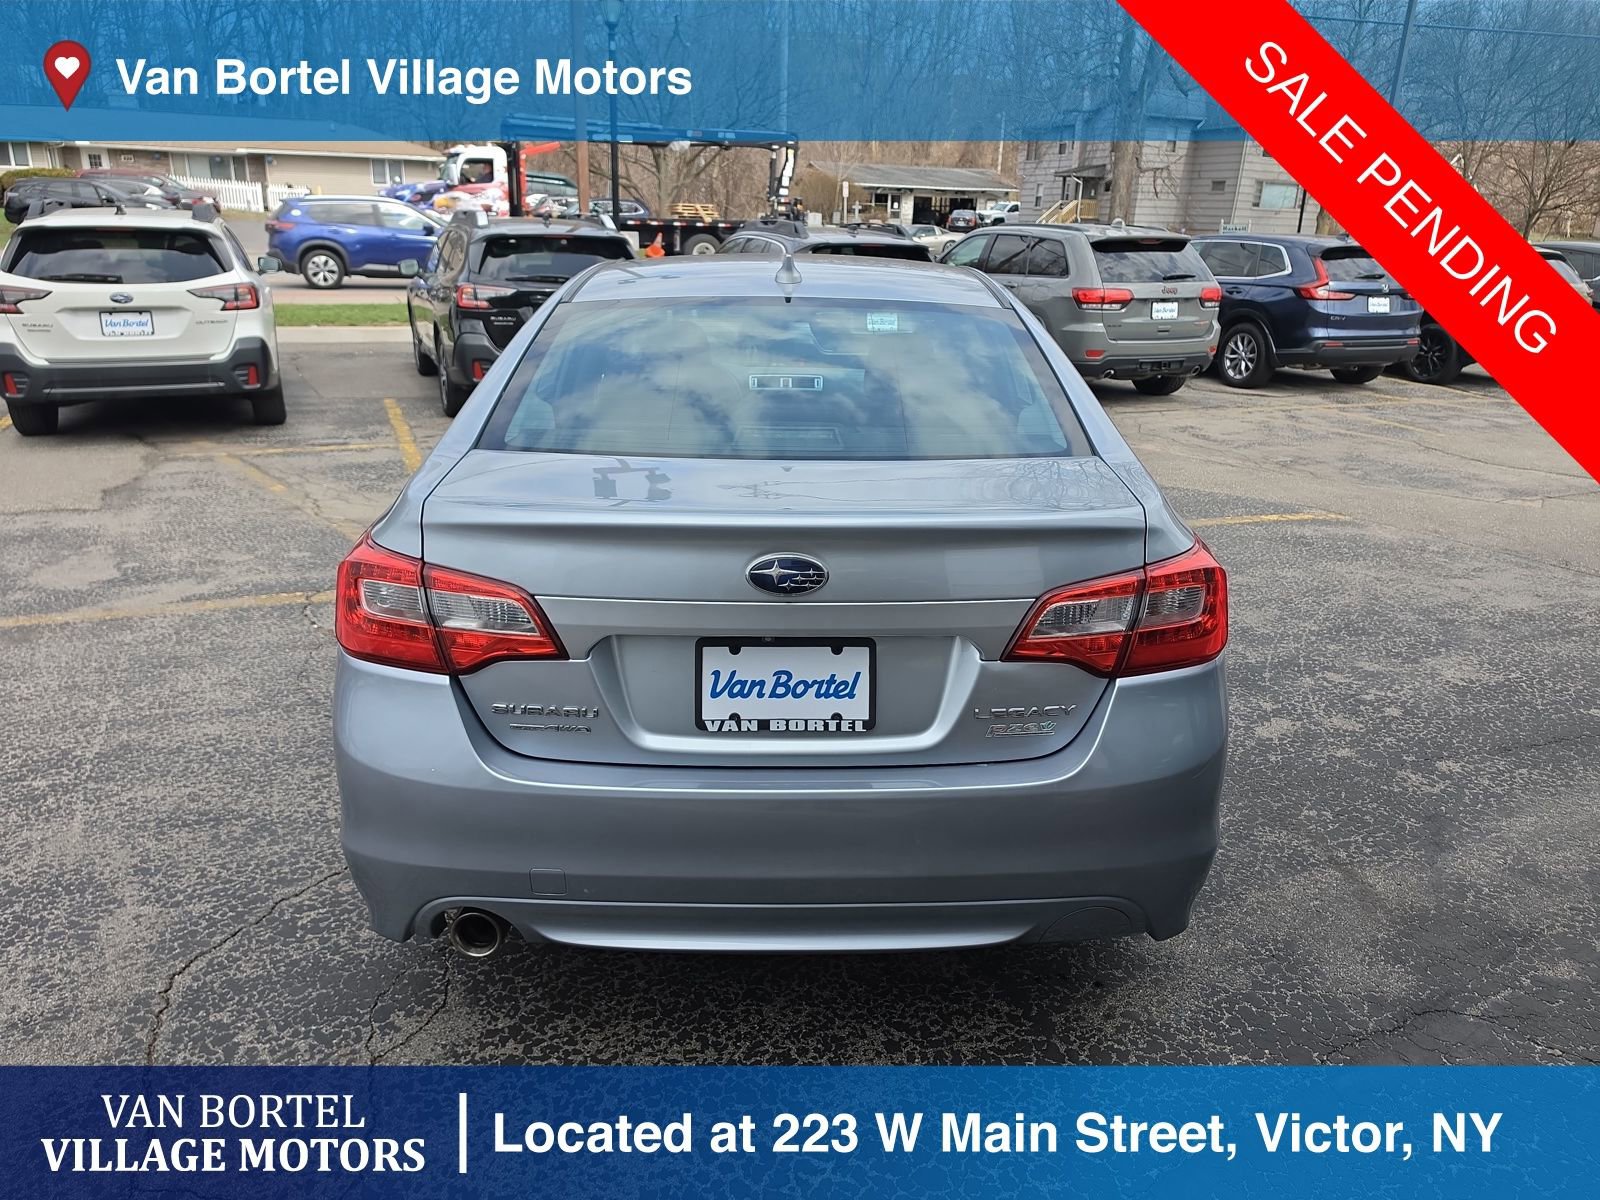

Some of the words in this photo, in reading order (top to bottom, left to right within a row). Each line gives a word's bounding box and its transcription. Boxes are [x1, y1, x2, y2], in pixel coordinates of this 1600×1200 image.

[105, 319, 121, 328] Van
[122, 319, 149, 328] Bortel
[709, 669, 767, 700] Van
[767, 669, 862, 700] Bortel
[491, 702, 599, 719] SUBARU
[974, 704, 1077, 720] LEGACY
[704, 719, 758, 732] VAN
[769, 719, 867, 732] BORTEL
